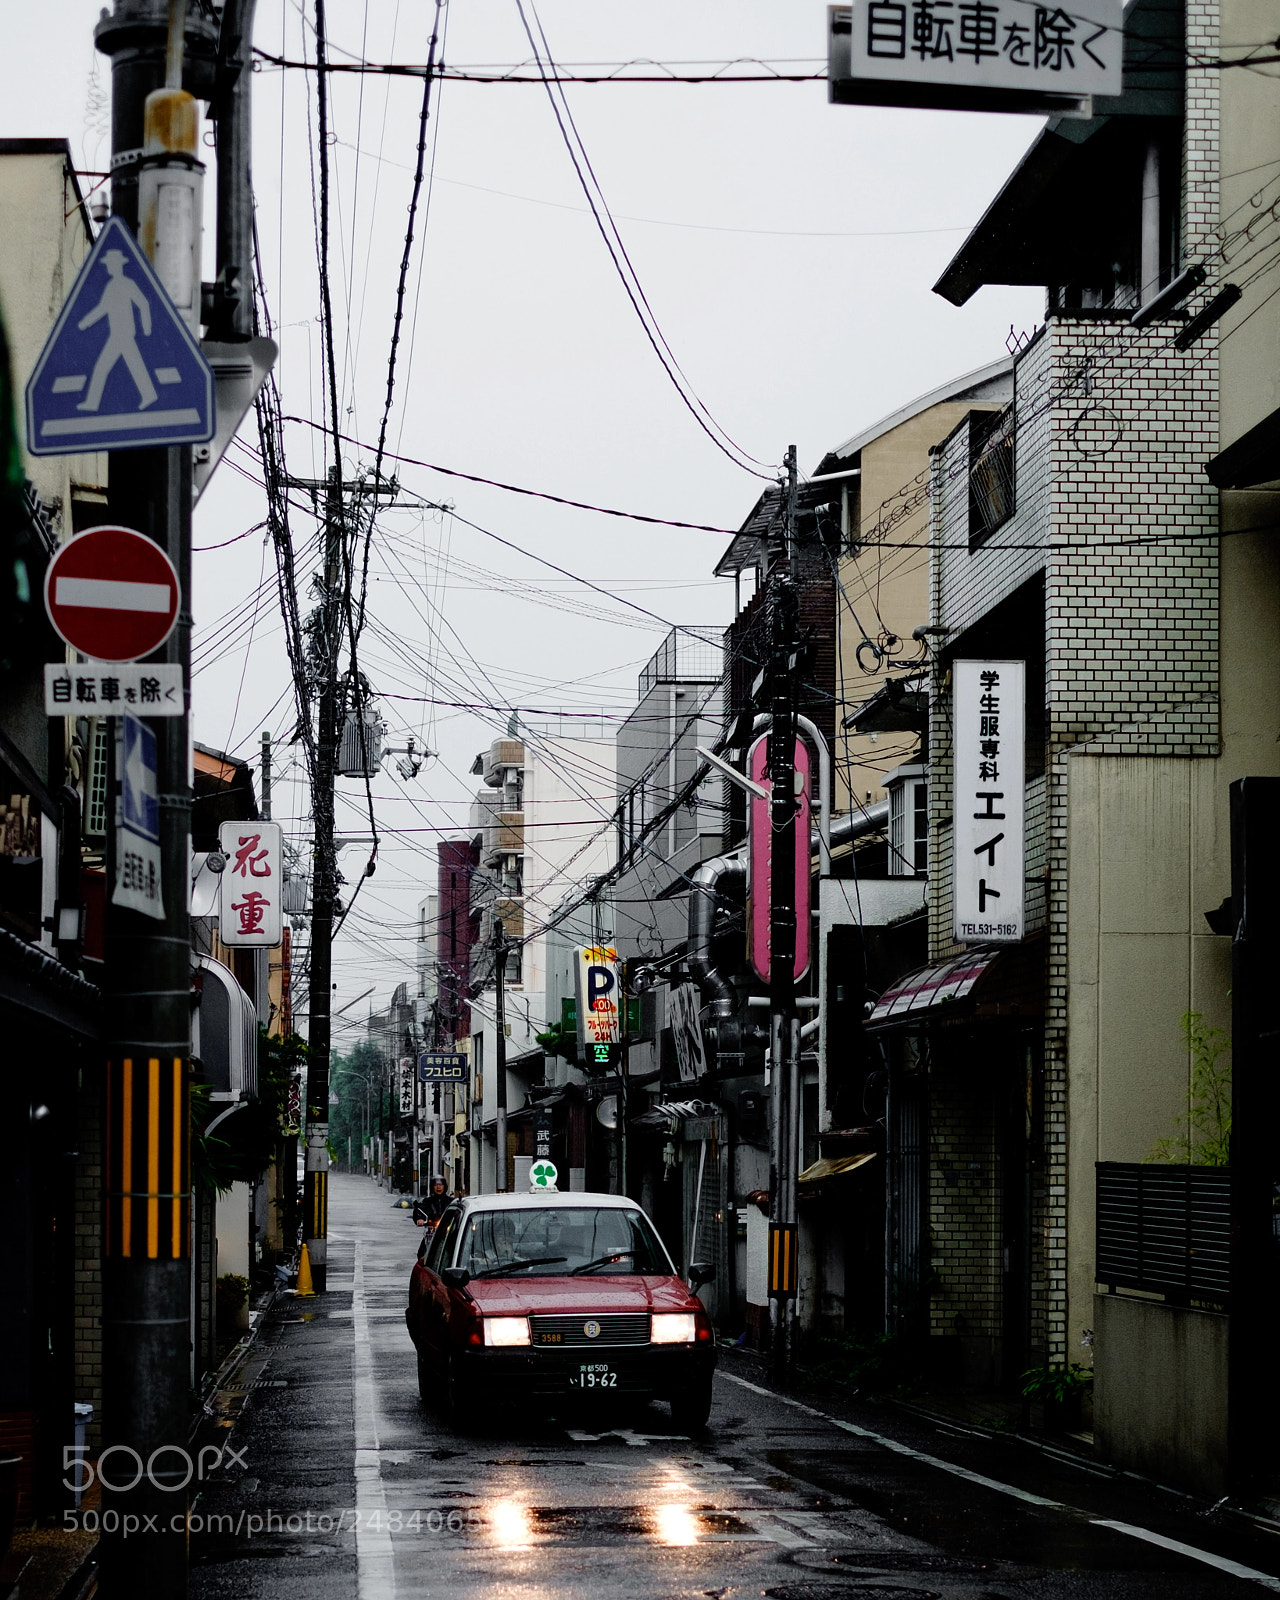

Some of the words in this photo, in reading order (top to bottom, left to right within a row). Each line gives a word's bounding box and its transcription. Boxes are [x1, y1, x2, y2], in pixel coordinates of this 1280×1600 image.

[867, 0, 1108, 71] 自転車を除く
[53, 676, 177, 703] 自転車を除く
[979, 670, 1000, 782] 学生服専科
[973, 792, 1006, 913] エイト
[231, 834, 271, 935] 花重
[588, 966, 615, 1012] P
[424, 1066, 462, 1077] フユヒロ
[593, 1044, 610, 1062] 空
[536, 1129, 550, 1161] 武藤
[580, 1372, 617, 1388] 19-62
